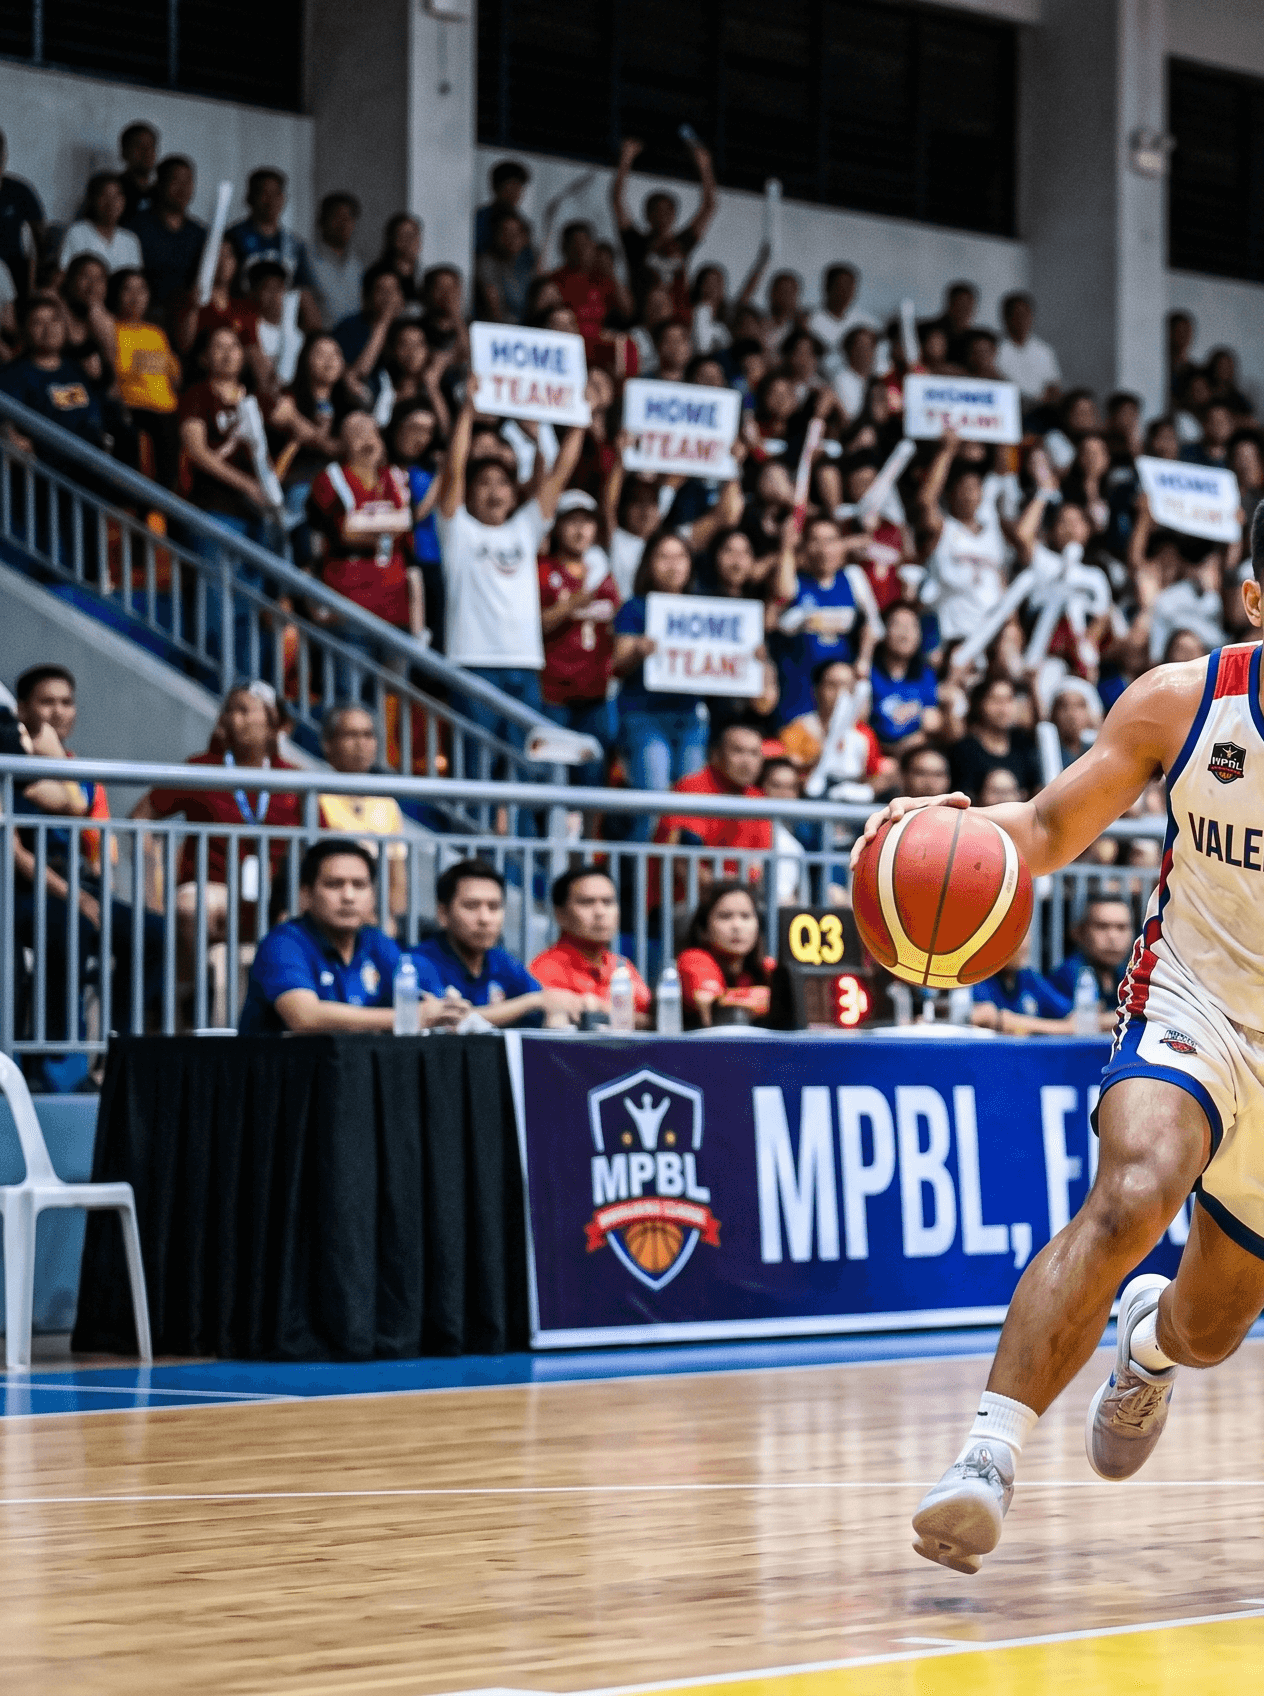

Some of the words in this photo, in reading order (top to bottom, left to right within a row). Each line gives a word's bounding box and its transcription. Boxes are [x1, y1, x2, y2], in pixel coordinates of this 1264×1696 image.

[490, 340, 568, 375] HOME
[645, 396, 719, 429] HOME
[666, 612, 742, 644] HOME
[789, 913, 844, 965] Q3
[591, 1151, 711, 1207] MPBL
[752, 1085, 1033, 1270] MPBL,
